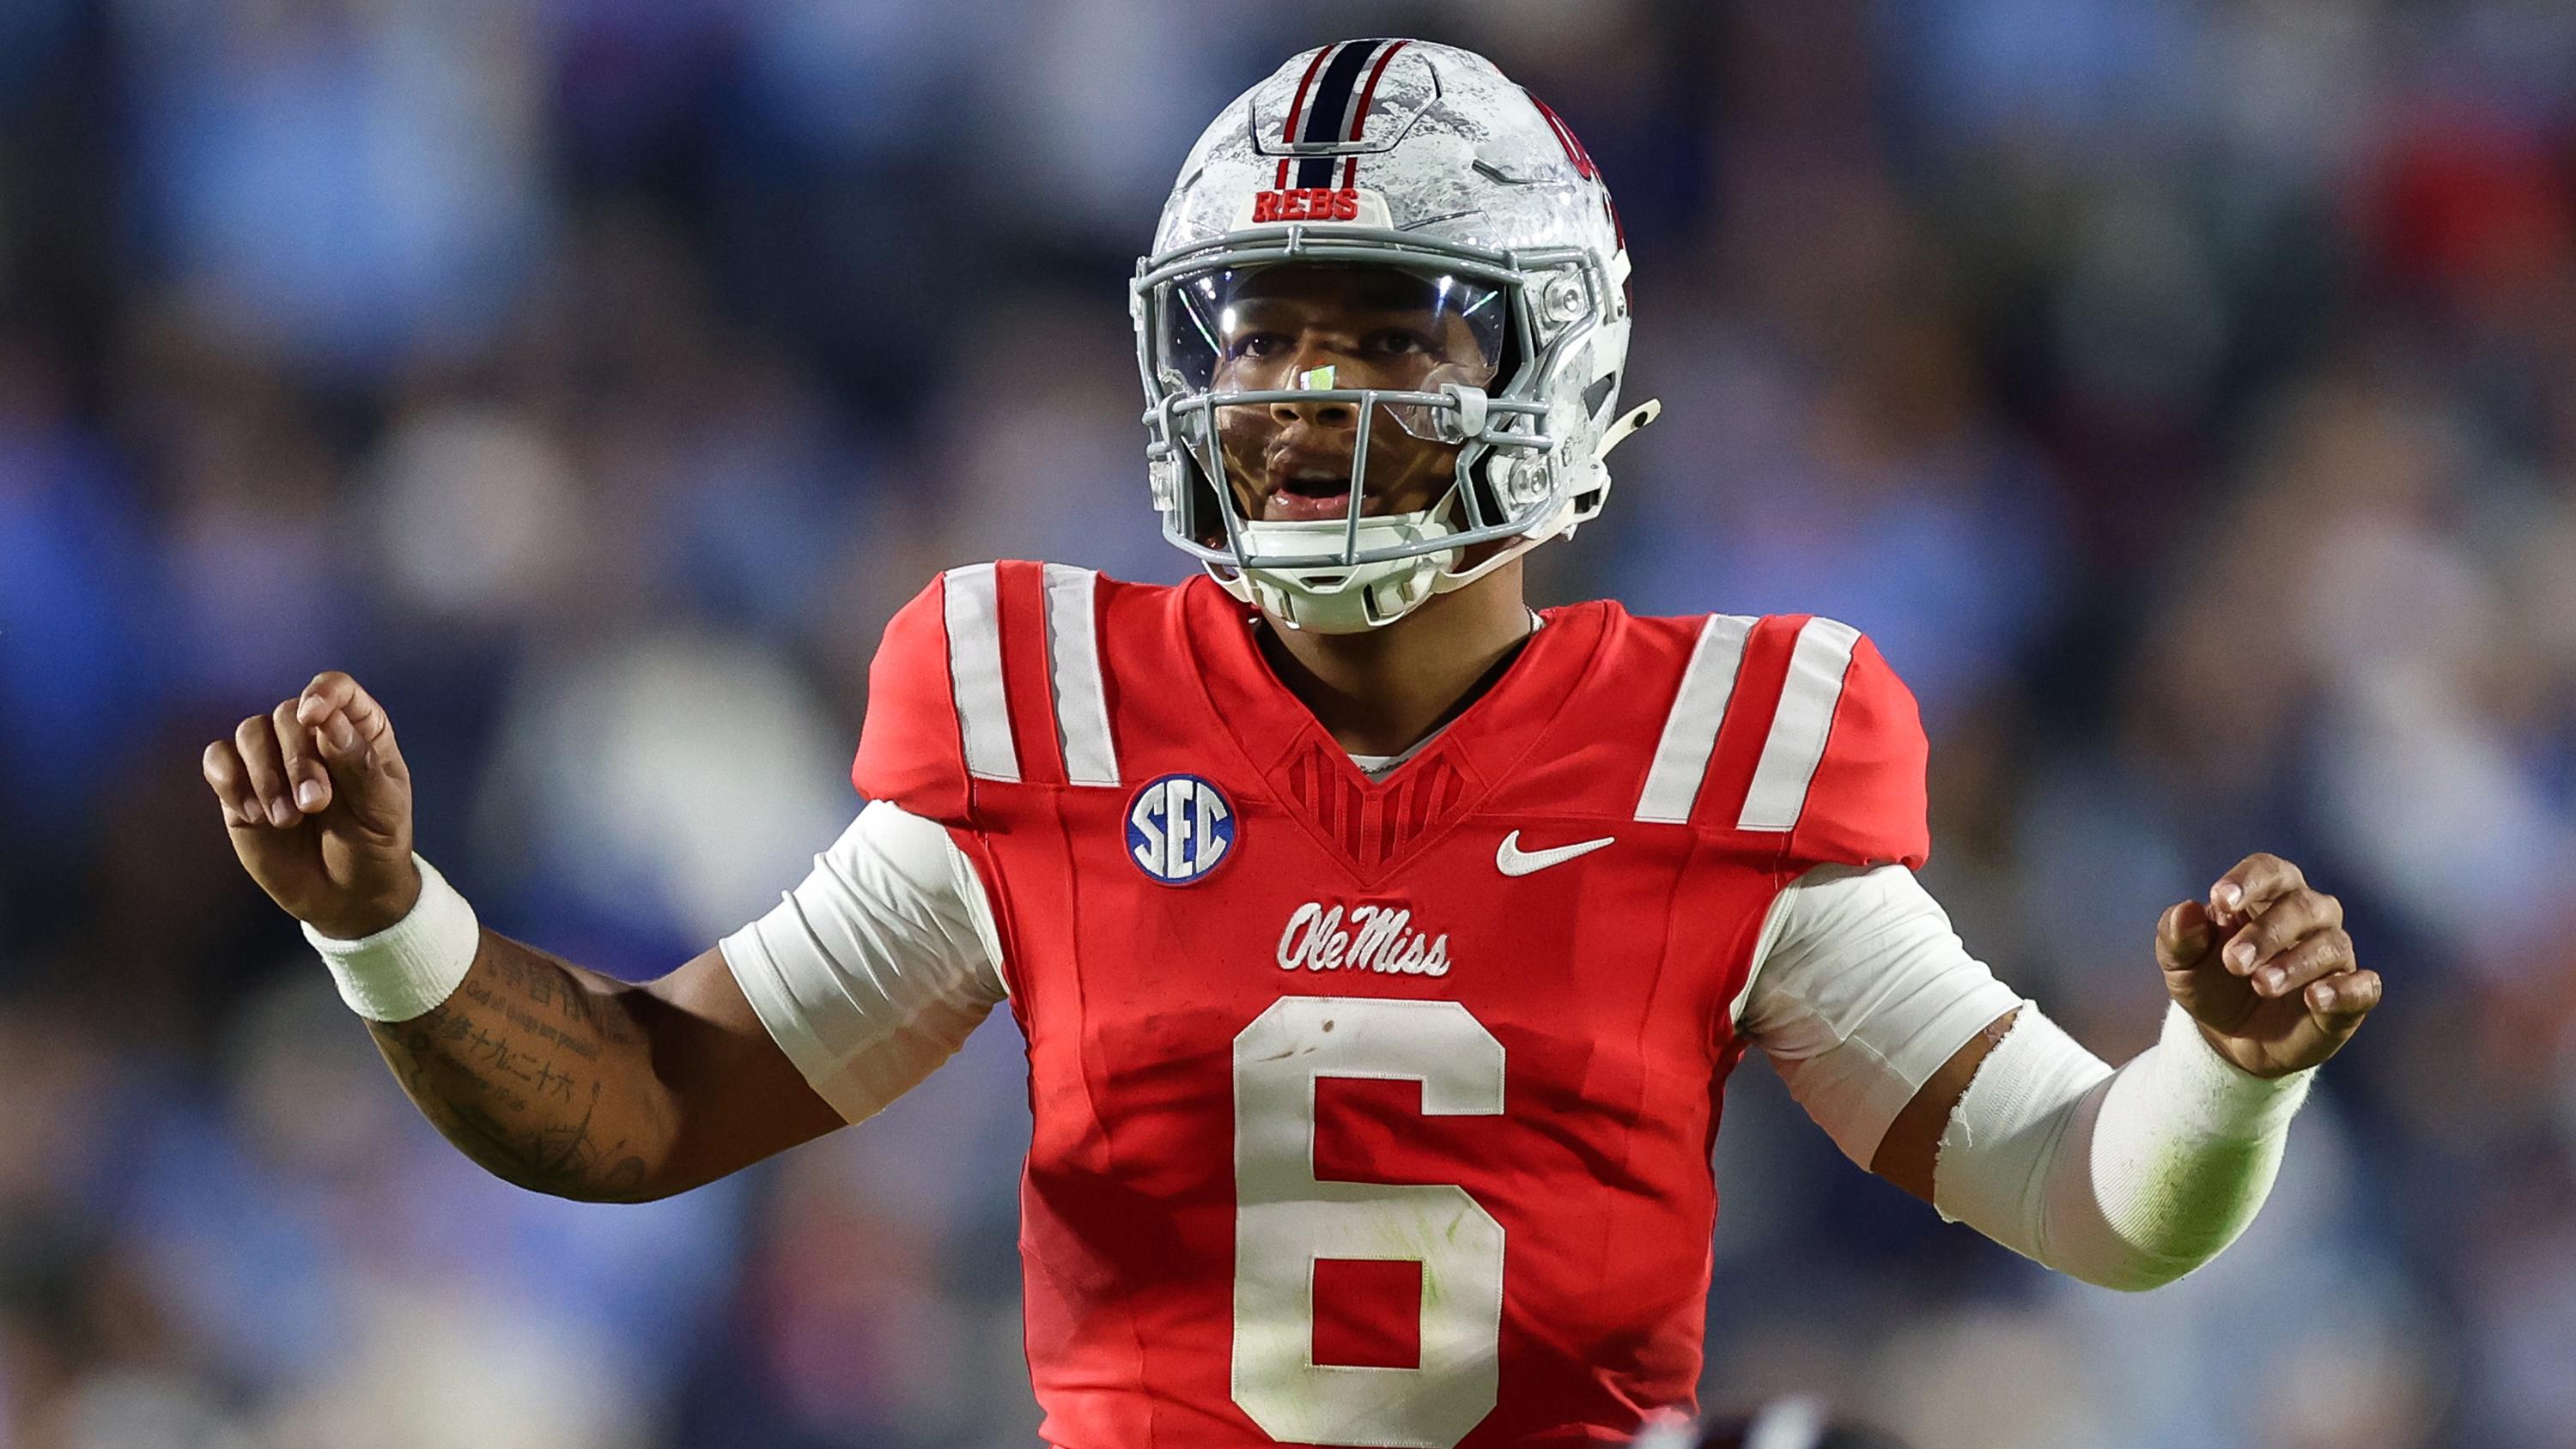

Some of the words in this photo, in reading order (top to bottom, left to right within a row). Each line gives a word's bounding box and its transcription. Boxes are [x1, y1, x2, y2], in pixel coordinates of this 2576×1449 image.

[1252, 187, 1359, 223] REBS
[1130, 779, 1229, 879] SEC
[1276, 901, 1348, 972] Ole
[1345, 904, 1452, 977] Miss
[1231, 995, 1506, 1449] 6
